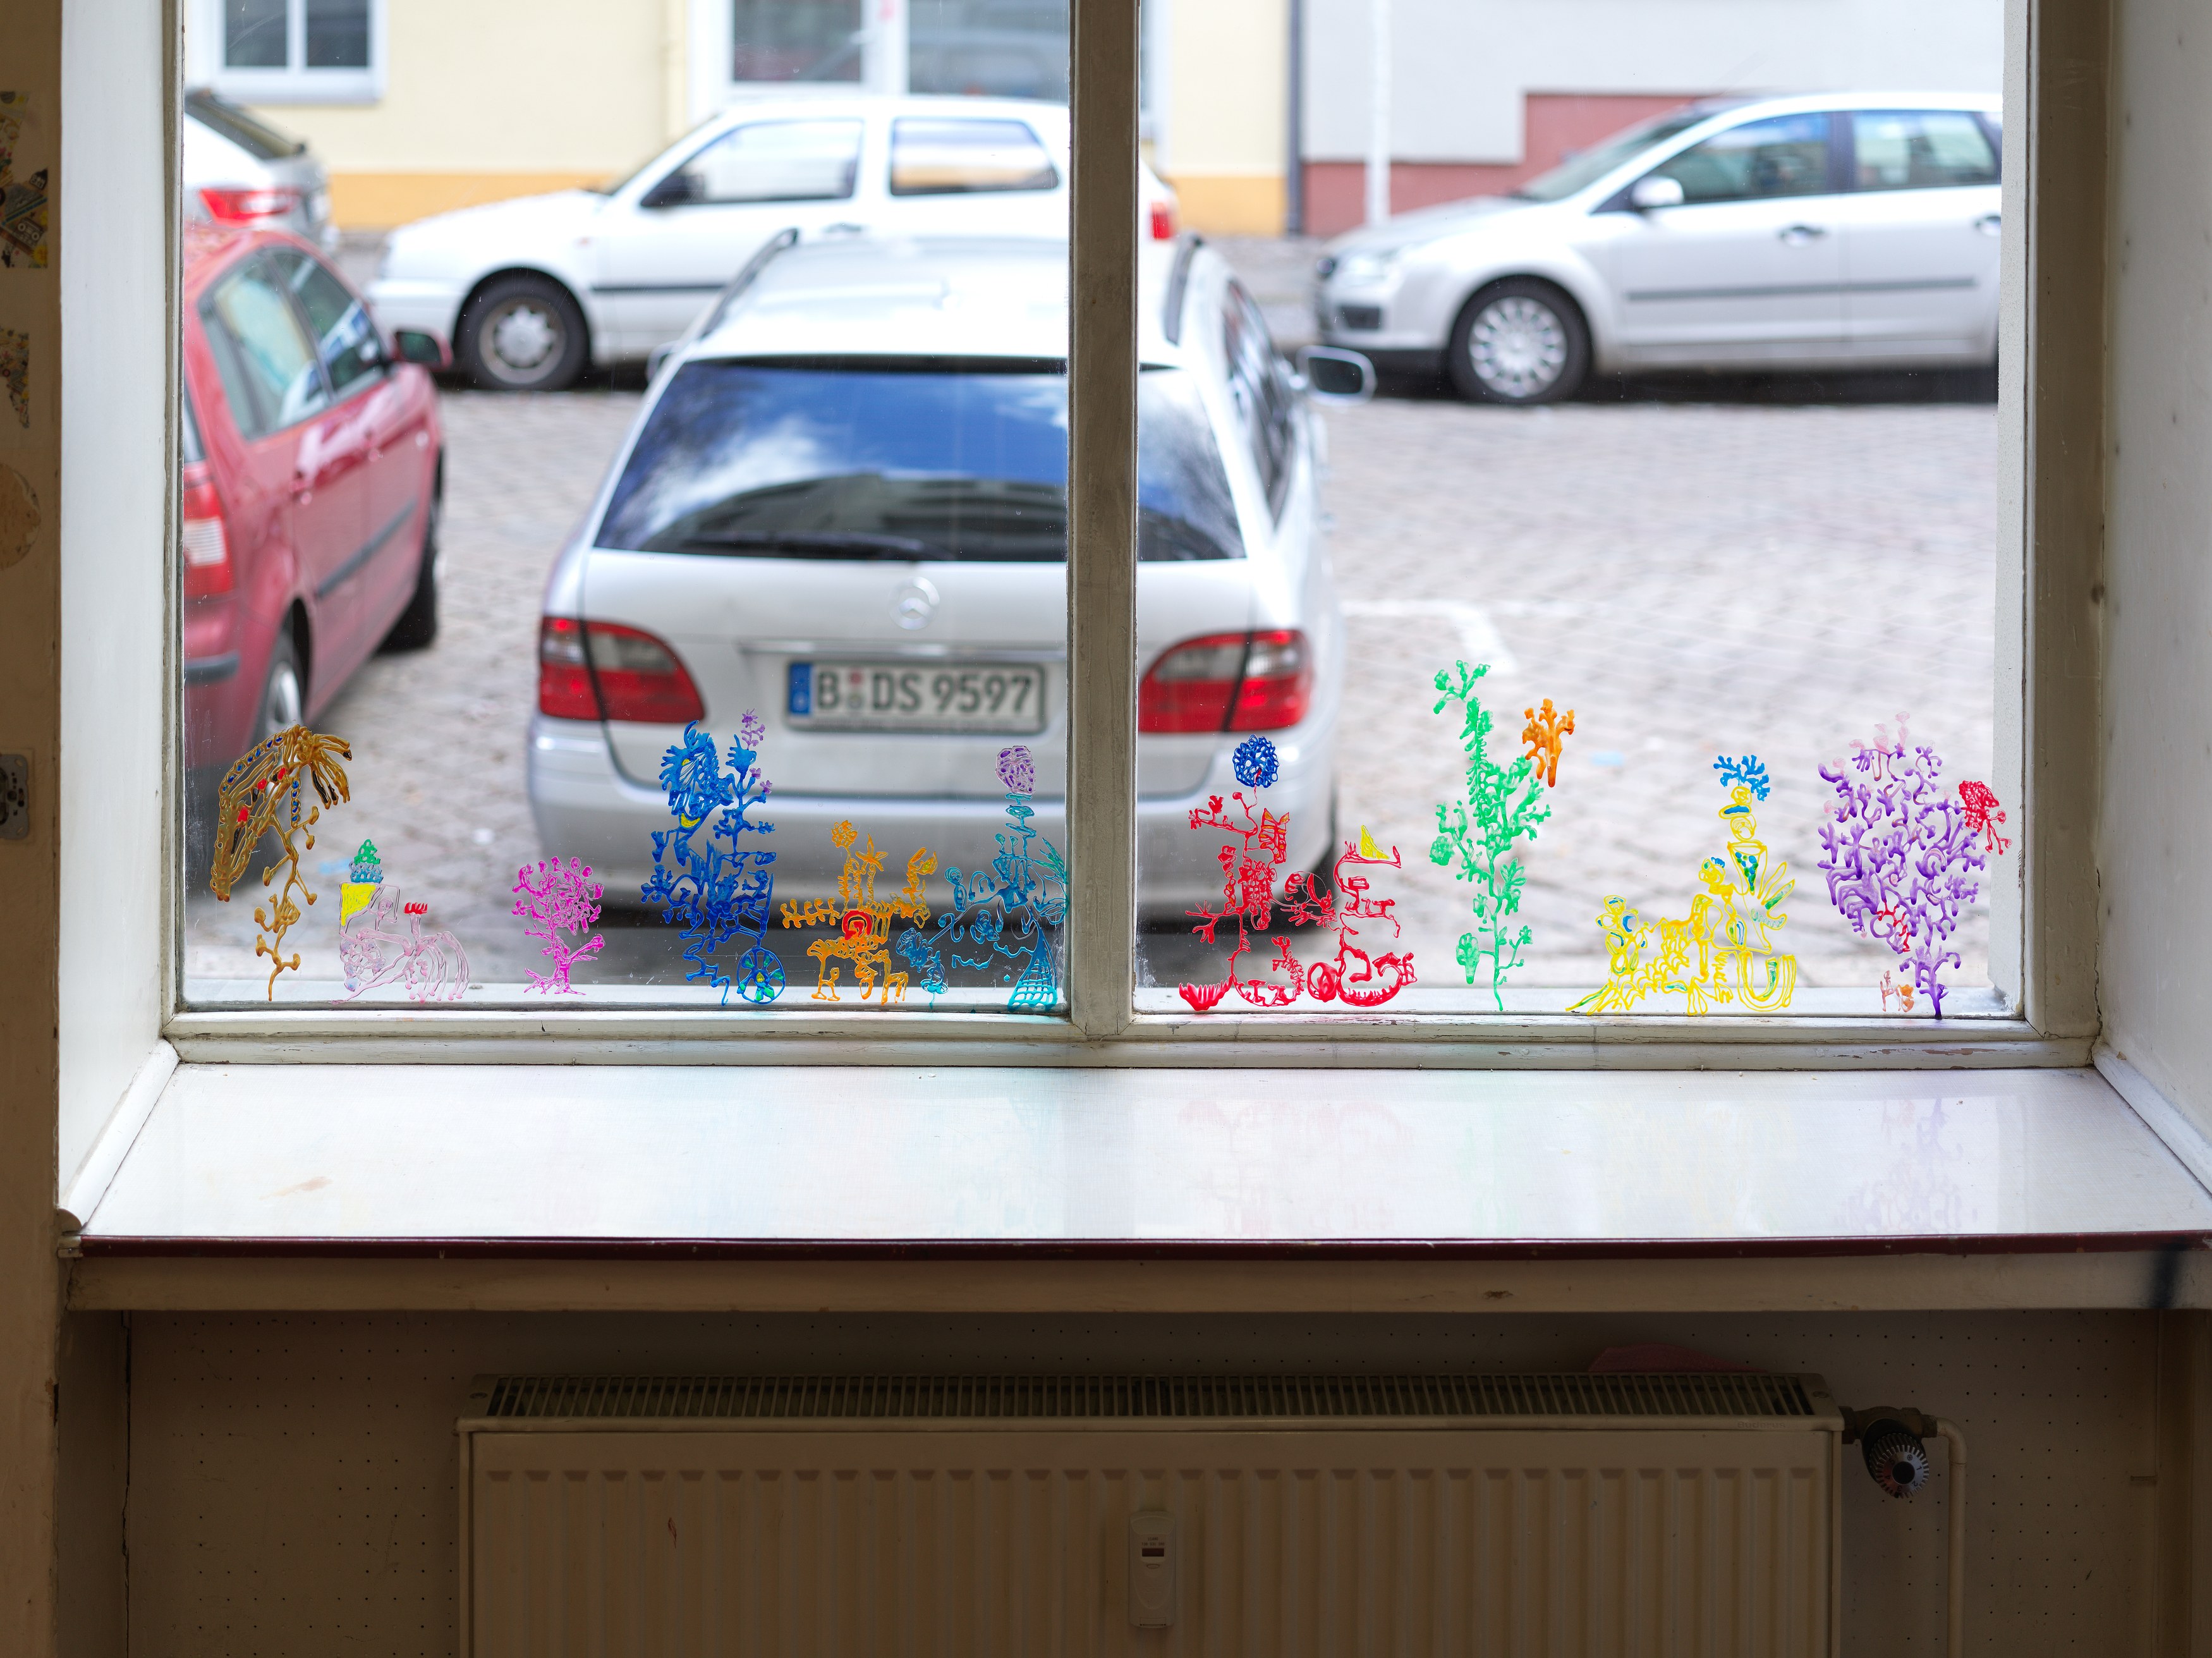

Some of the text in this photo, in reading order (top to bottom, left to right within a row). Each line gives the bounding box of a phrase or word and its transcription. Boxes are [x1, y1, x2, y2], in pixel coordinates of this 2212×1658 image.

[817, 671, 1032, 713] B DS 9597
